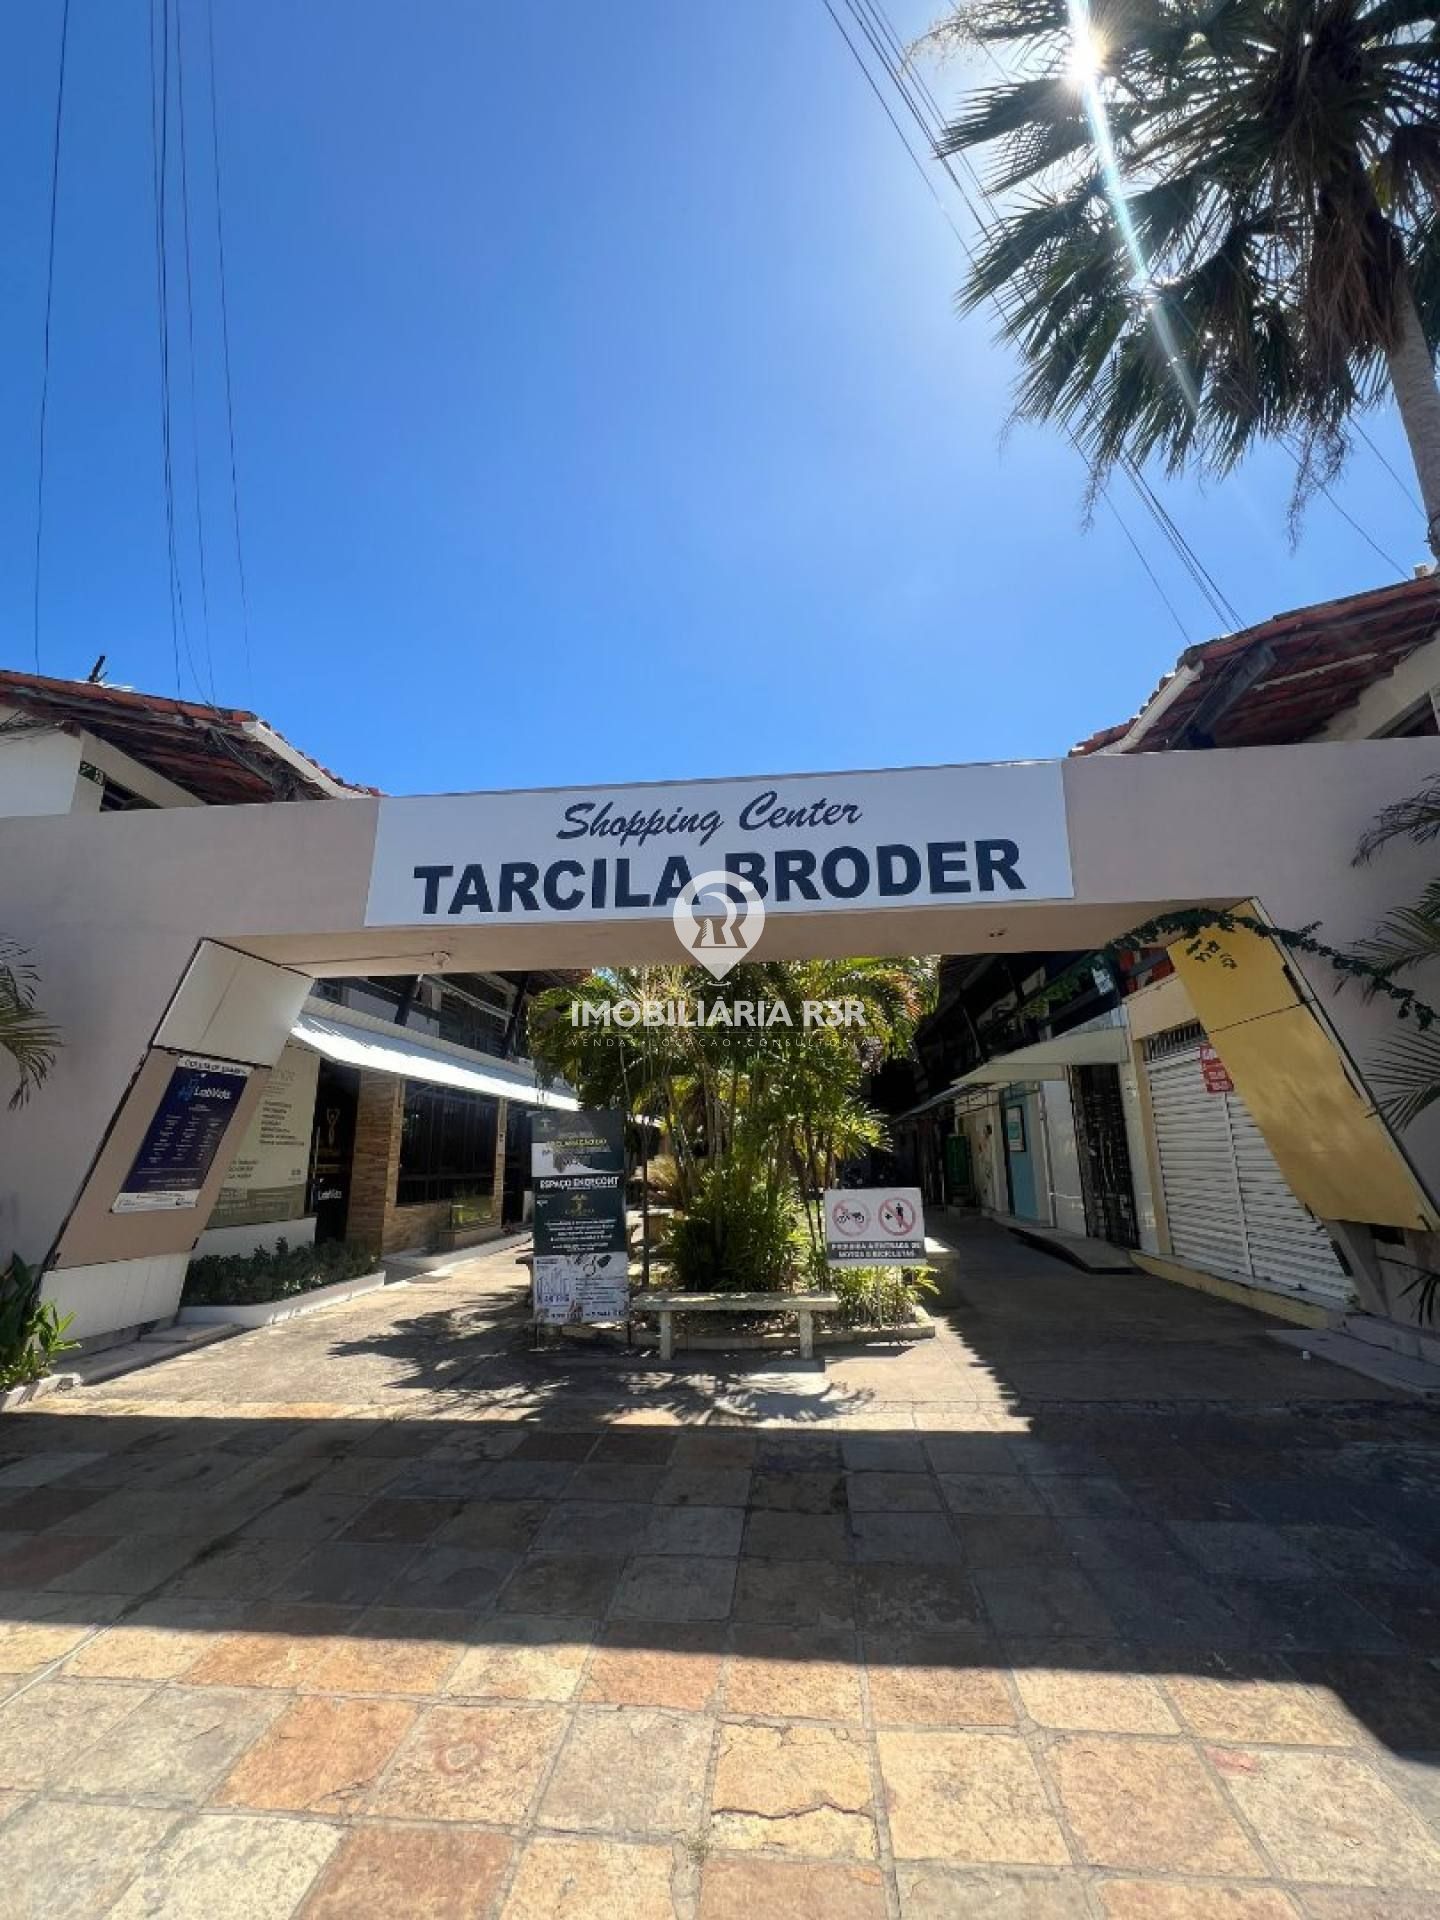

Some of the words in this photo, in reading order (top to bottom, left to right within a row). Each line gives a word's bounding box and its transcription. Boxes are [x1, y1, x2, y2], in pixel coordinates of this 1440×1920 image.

[556, 801, 725, 847] Shopping
[739, 790, 863, 831] Center
[413, 854, 701, 915] TARCILA
[724, 838, 1026, 903] BRODER
